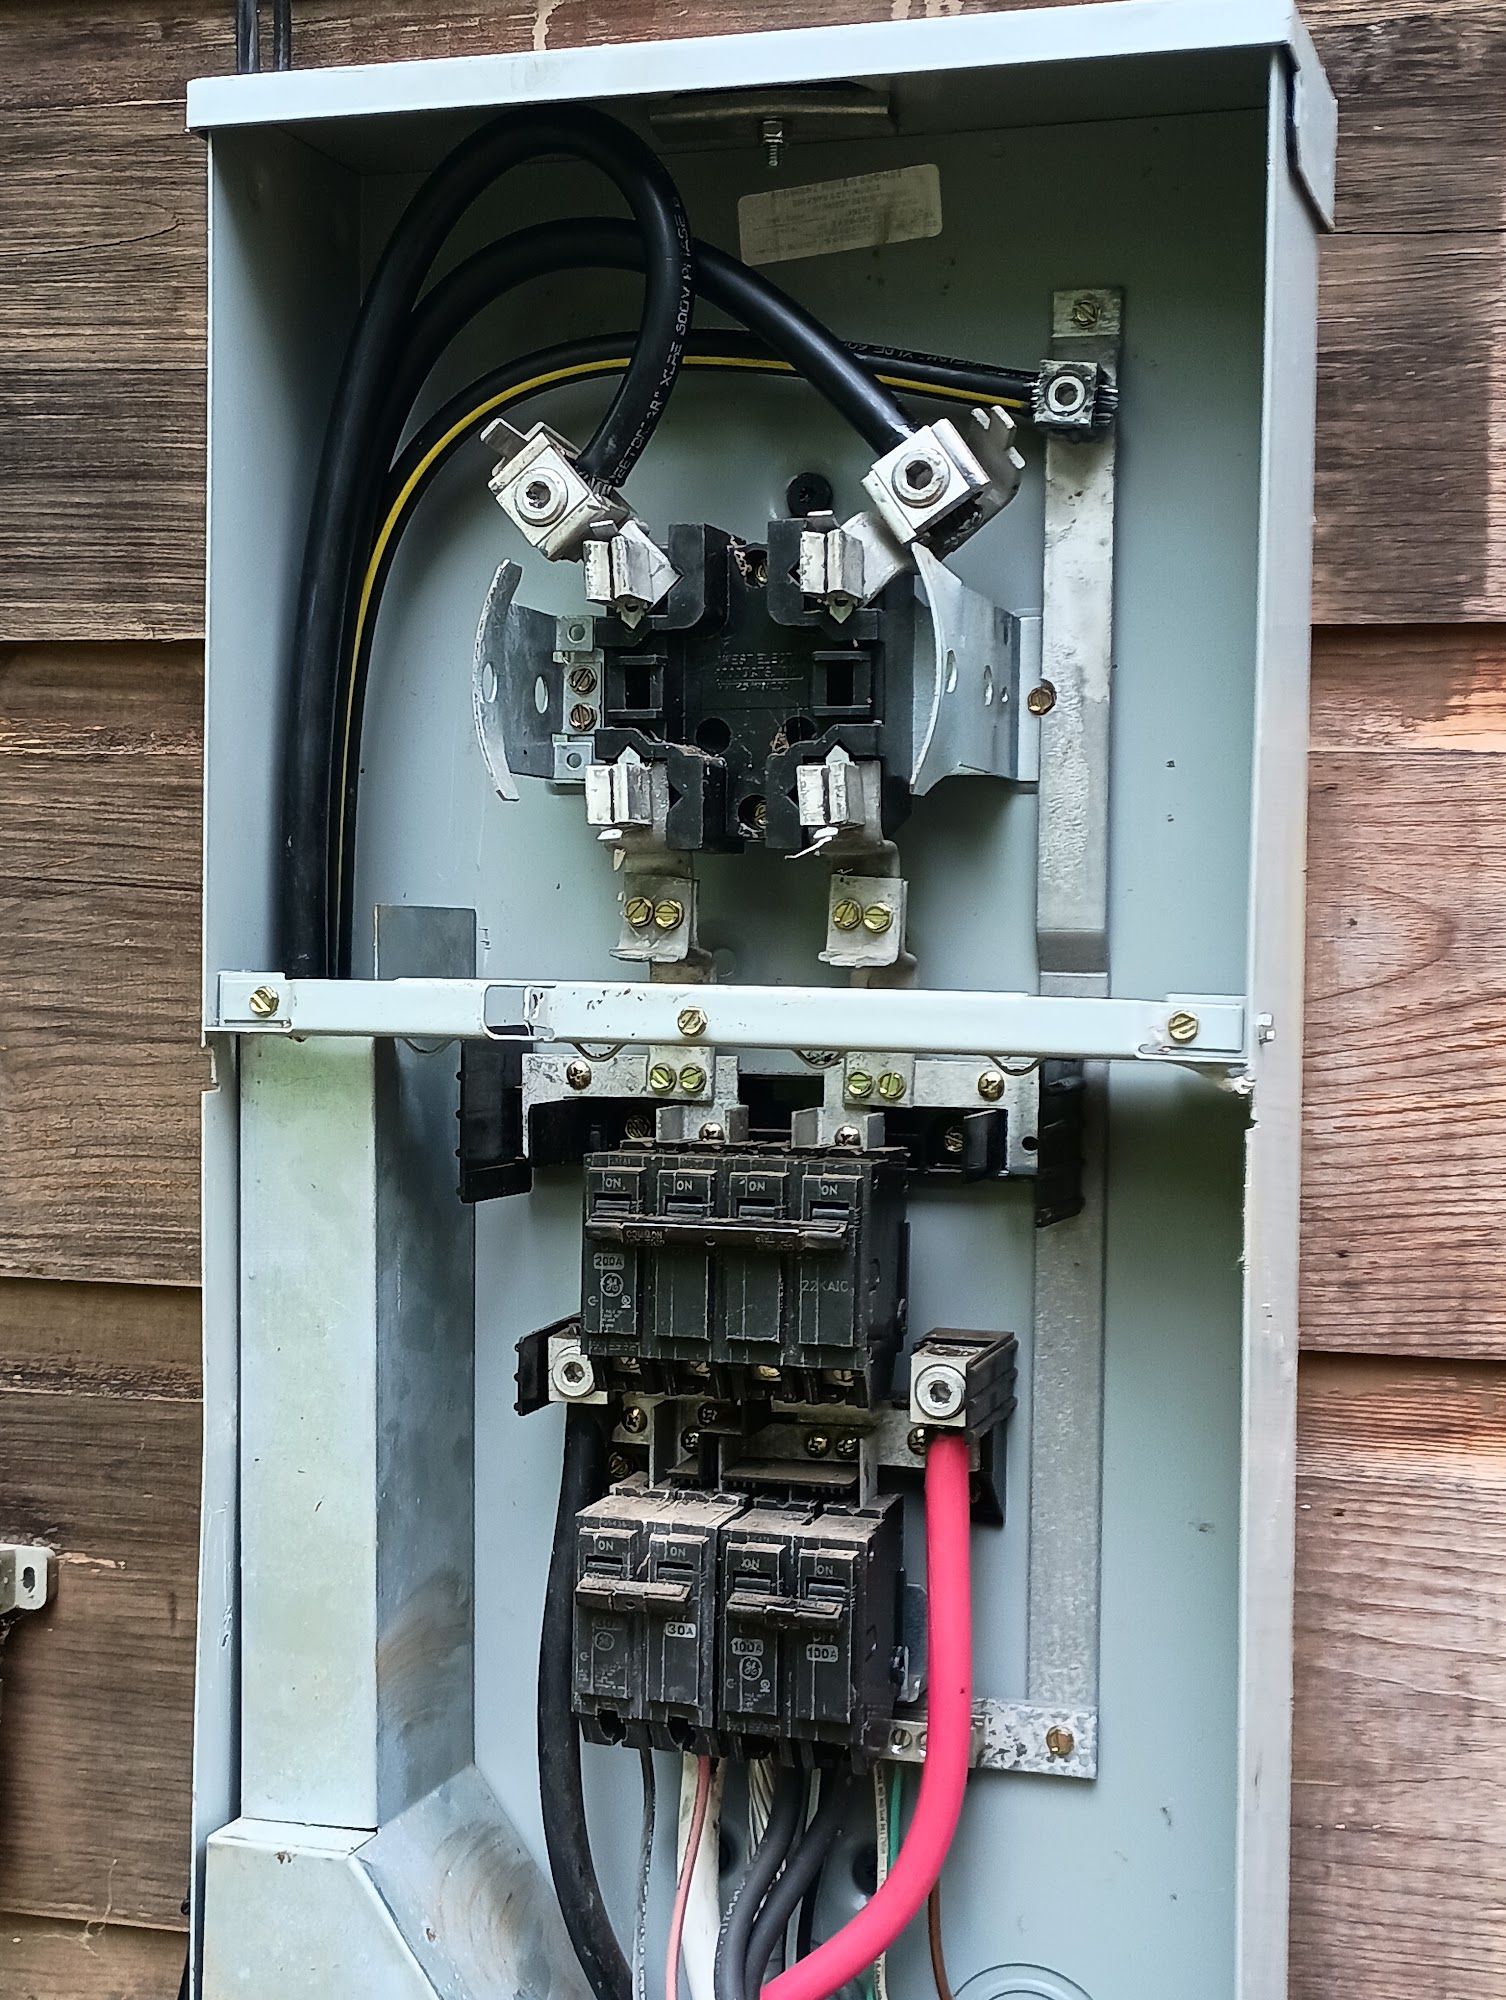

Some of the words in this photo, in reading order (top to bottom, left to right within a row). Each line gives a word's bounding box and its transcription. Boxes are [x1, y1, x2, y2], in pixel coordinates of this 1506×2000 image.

[605, 1177, 621, 1189] ON
[676, 1180, 693, 1191] ON
[748, 1181, 766, 1192] ON
[820, 1184, 838, 1196] ON
[594, 1255, 623, 1267] 200A
[598, 1540, 614, 1551] ON
[669, 1546, 686, 1557] ON
[743, 1558, 760, 1569] ON
[816, 1564, 834, 1575] ON
[667, 1623, 694, 1636] 30A
[733, 1640, 763, 1653] 100A
[807, 1646, 838, 1659] 100A
